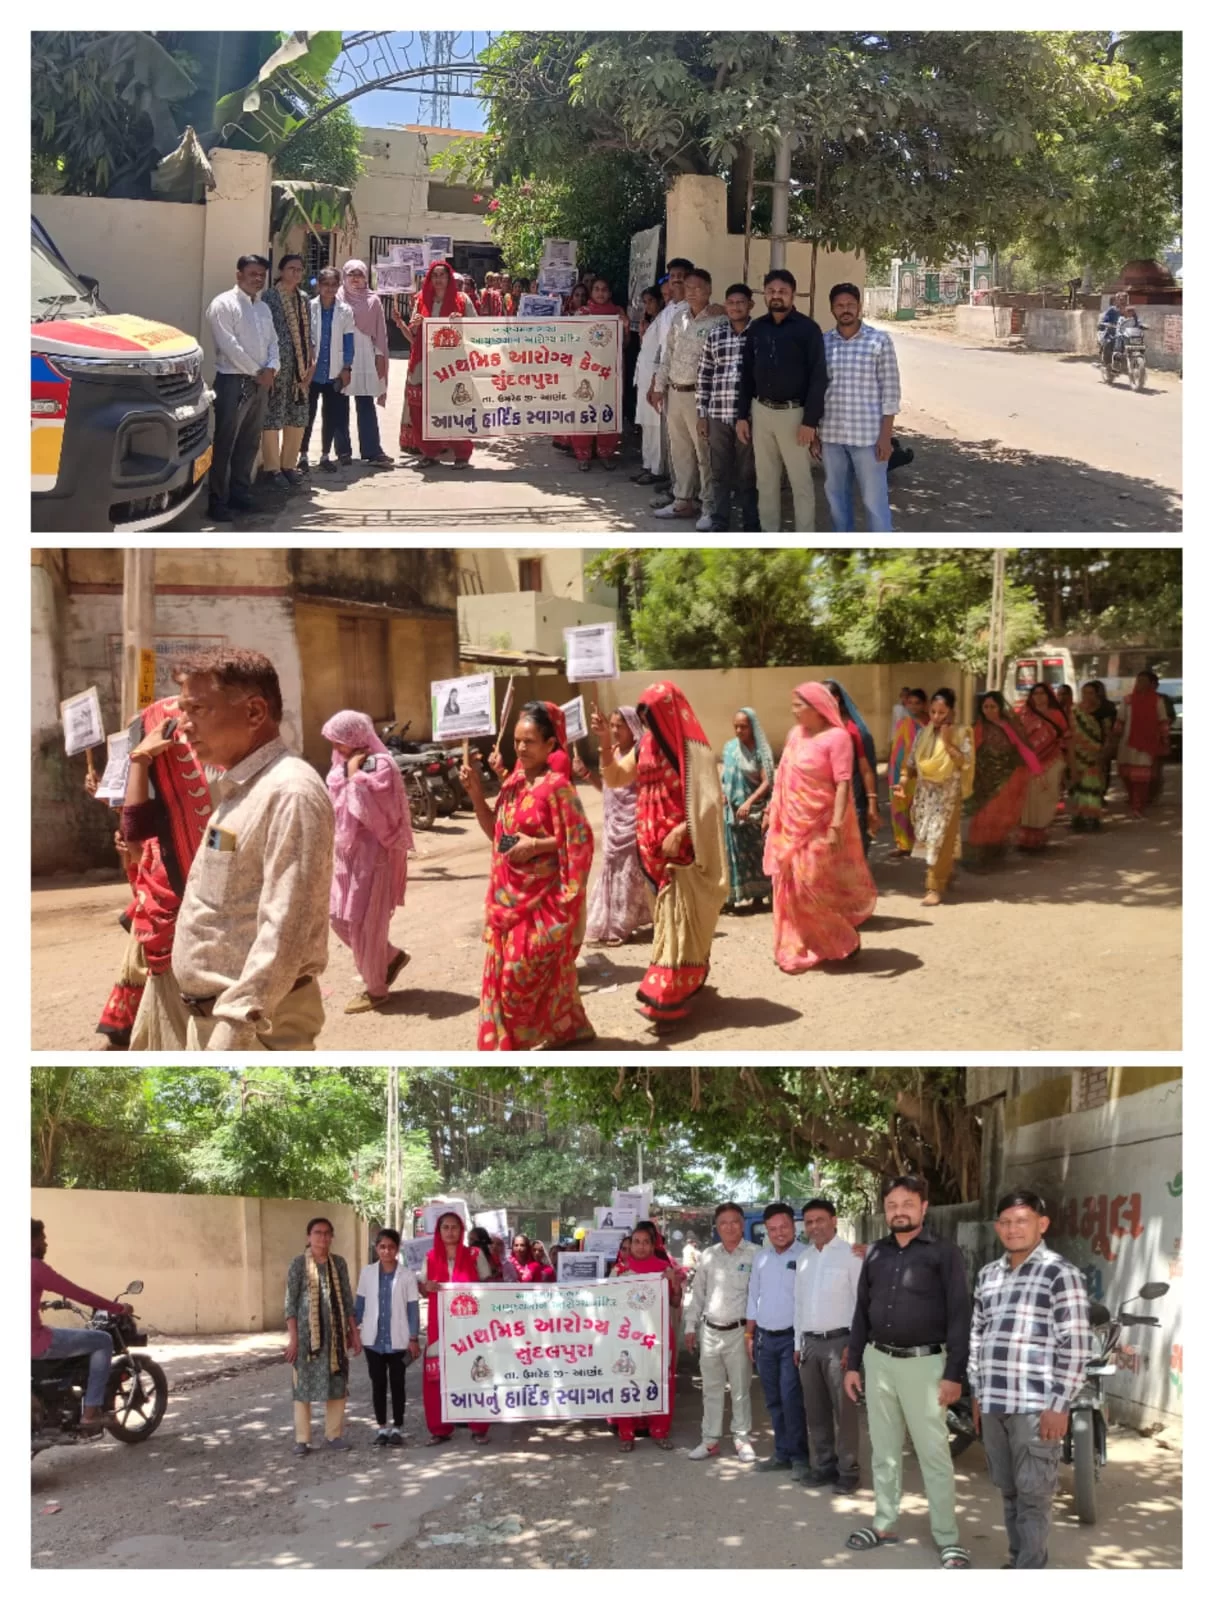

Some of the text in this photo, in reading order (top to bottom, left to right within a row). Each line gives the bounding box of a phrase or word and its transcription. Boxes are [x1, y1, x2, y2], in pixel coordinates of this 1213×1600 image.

[433, 345, 612, 383] પ્રાથમિક આરોગ્ય કેન્દ્ર
[491, 369, 559, 391] સુંદલપુરા
[540, 392, 568, 401] આણંદ
[431, 404, 614, 434] આપનું હાર્દિક સ્વાગત કરે છે
[450, 1312, 656, 1356] પ્રાથમિક આરોગ્ય કેન્દ્ર
[515, 1341, 594, 1366] સુંદલપુરા
[572, 1365, 604, 1376] આણંદ
[450, 1379, 659, 1415] આપનું હાર્દિક સ્વાગત કરે છે
